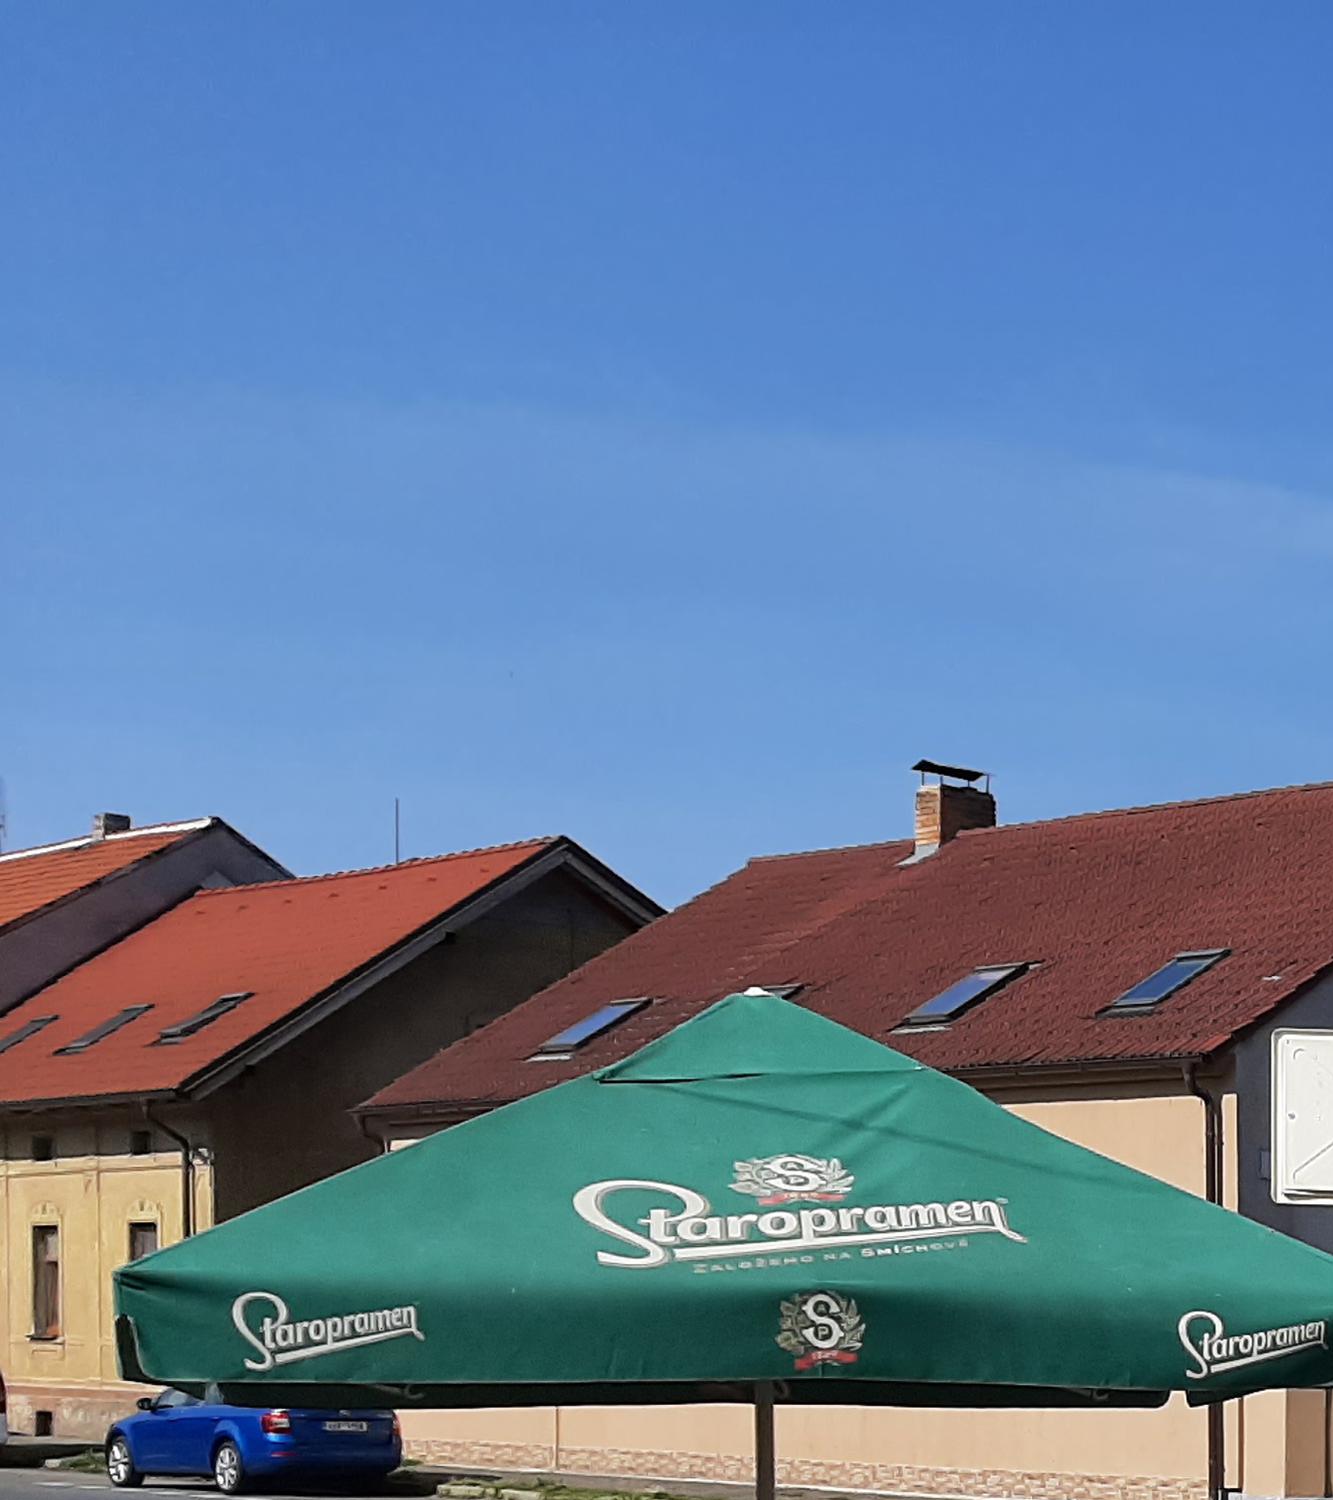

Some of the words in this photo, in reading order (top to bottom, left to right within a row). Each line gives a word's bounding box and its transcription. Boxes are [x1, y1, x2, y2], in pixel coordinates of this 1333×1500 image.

[573, 1179, 1028, 1268] Staropramen
[232, 1291, 425, 1370] Staropramen
[1178, 1311, 1329, 1379] Staropramen
